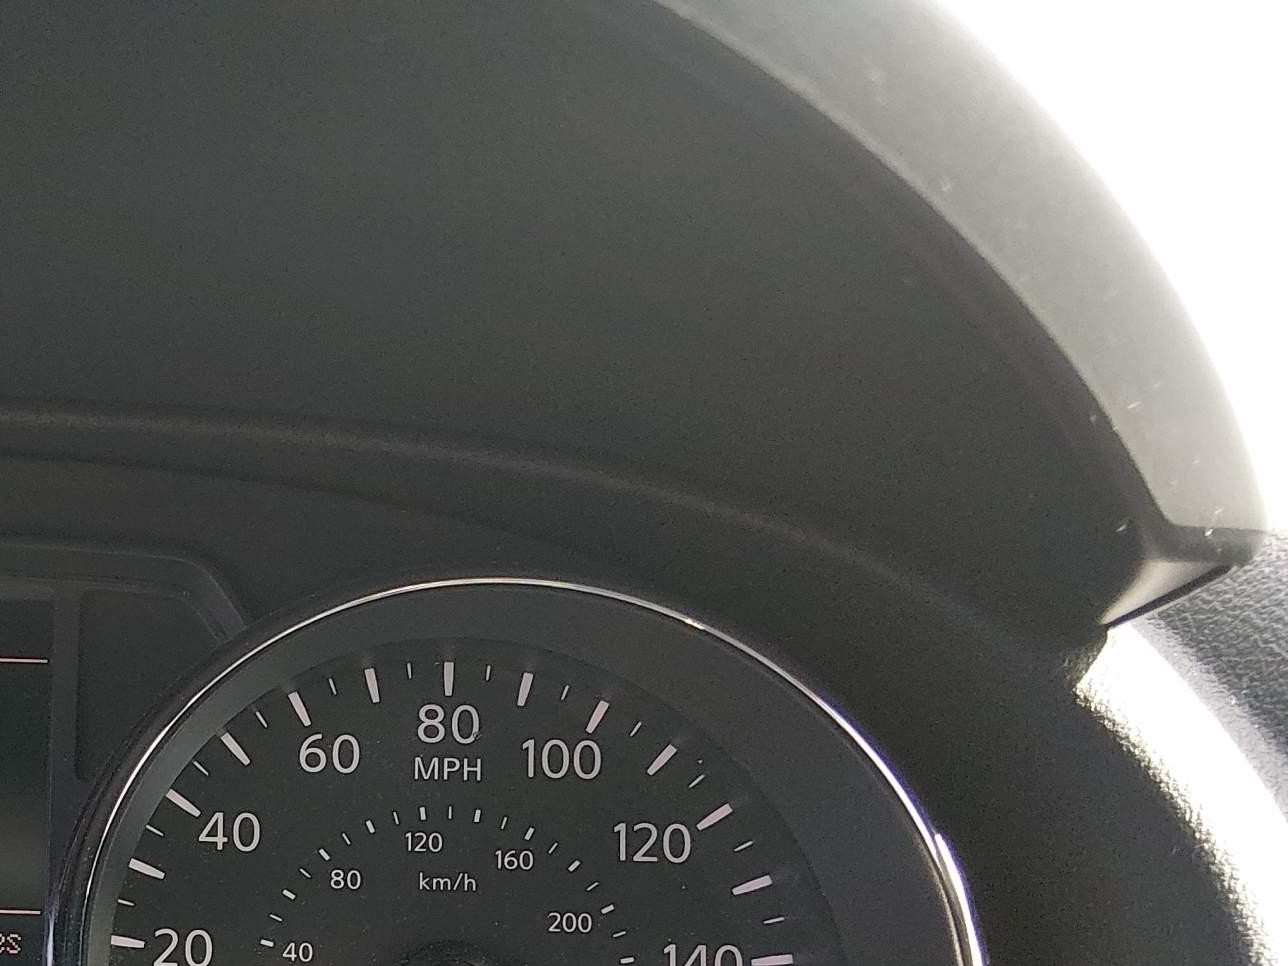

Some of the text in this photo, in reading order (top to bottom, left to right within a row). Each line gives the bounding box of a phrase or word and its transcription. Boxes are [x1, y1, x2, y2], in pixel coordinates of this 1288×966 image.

[416, 704, 481, 745] 80
[299, 733, 361, 775] 60
[521, 738, 602, 780] 100
[413, 756, 483, 782] MPH
[197, 811, 261, 852] 40
[404, 832, 443, 853] 120
[612, 822, 692, 864] 120
[495, 850, 534, 871] 160
[329, 869, 361, 890] 80
[418, 871, 477, 893] km/h
[547, 912, 592, 933] 200
[282, 942, 314, 963] 40
